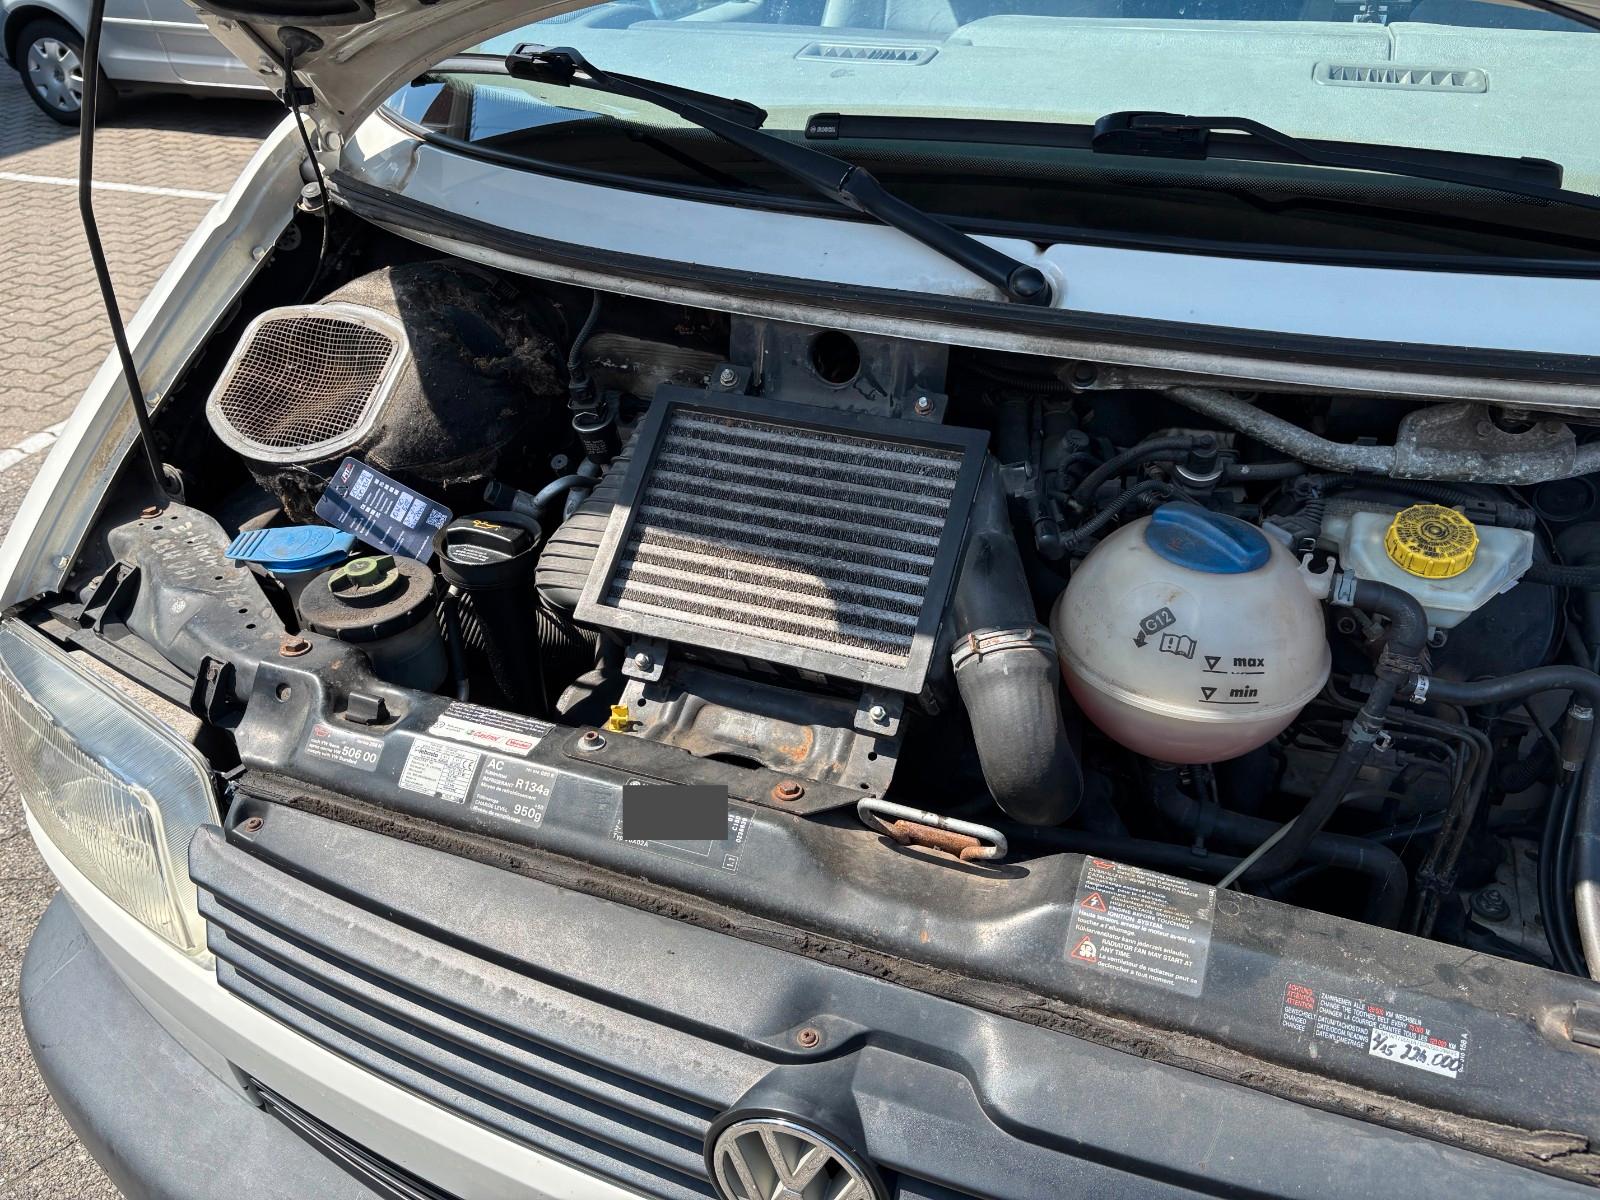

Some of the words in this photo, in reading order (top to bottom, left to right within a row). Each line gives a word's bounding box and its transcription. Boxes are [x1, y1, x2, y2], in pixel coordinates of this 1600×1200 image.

[1146, 610, 1173, 631] G12
[1233, 656, 1265, 668] max
[1229, 685, 1258, 698] min
[341, 745, 362, 760] 506
[362, 751, 377, 764] 00
[487, 758, 505, 771] AC
[515, 778, 551, 797] R134a
[512, 804, 543, 823] 950g
[1107, 911, 1135, 923] IGNITION
[1100, 946, 1114, 954] ANY
[1101, 939, 1134, 952] RADIATOR
[1134, 947, 1148, 956] FAN
[1148, 950, 1162, 959] MAY
[1162, 954, 1184, 965] START
[1175, 972, 1191, 982] peut
[1283, 1014, 1307, 1026] CHANGED
[1318, 1007, 1343, 1021] CHANGER
[1319, 1000, 1340, 1012] CHANGE
[1352, 1008, 1377, 1021] TOOTHED
[1377, 1014, 1390, 1025] BELT
[1390, 1018, 1408, 1029] EVERY
